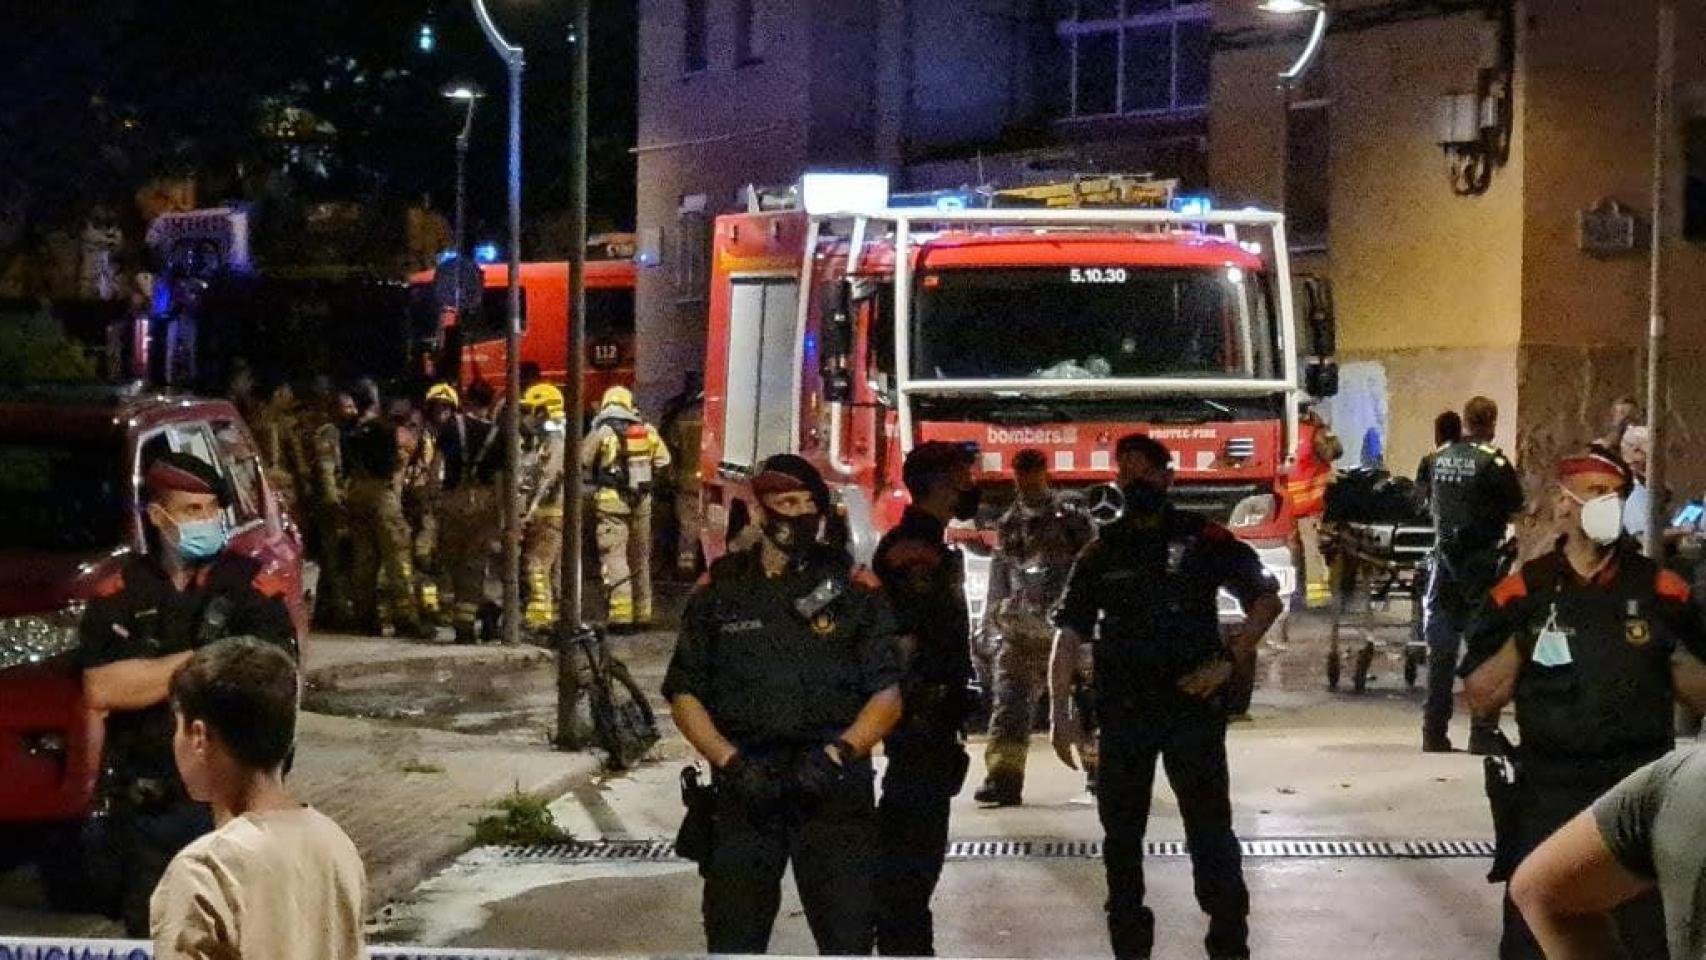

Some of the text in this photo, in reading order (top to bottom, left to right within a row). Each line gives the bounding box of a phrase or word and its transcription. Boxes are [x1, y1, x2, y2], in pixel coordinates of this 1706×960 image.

[1070, 268, 1126, 283] 5.10.30
[596, 345, 617, 360] 112
[987, 424, 1061, 443] bombers
